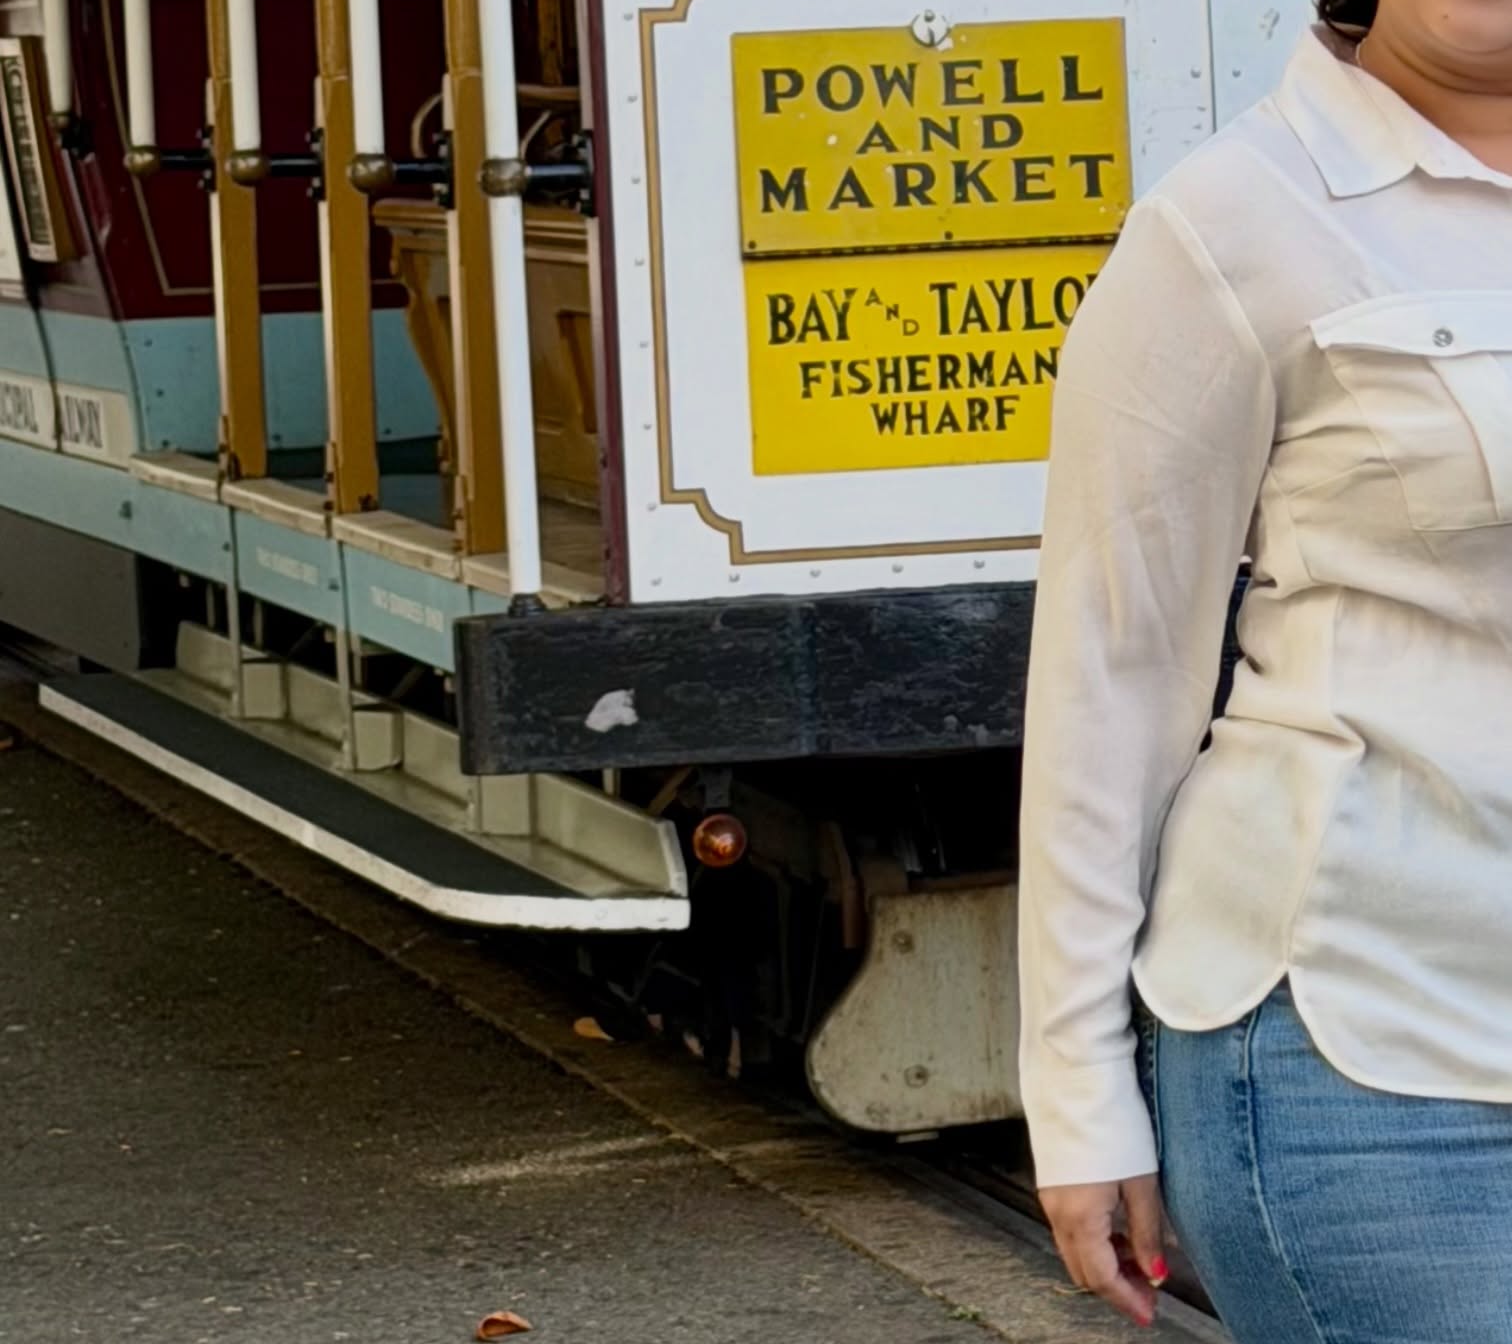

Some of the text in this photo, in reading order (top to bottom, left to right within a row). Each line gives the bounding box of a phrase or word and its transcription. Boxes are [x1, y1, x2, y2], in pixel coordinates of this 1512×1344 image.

[760, 55, 1104, 115] POWELL
[855, 113, 1025, 155] AND
[759, 153, 1115, 214] MARKET
[767, 287, 857, 346] BAY
[871, 394, 1021, 437] WHARF
